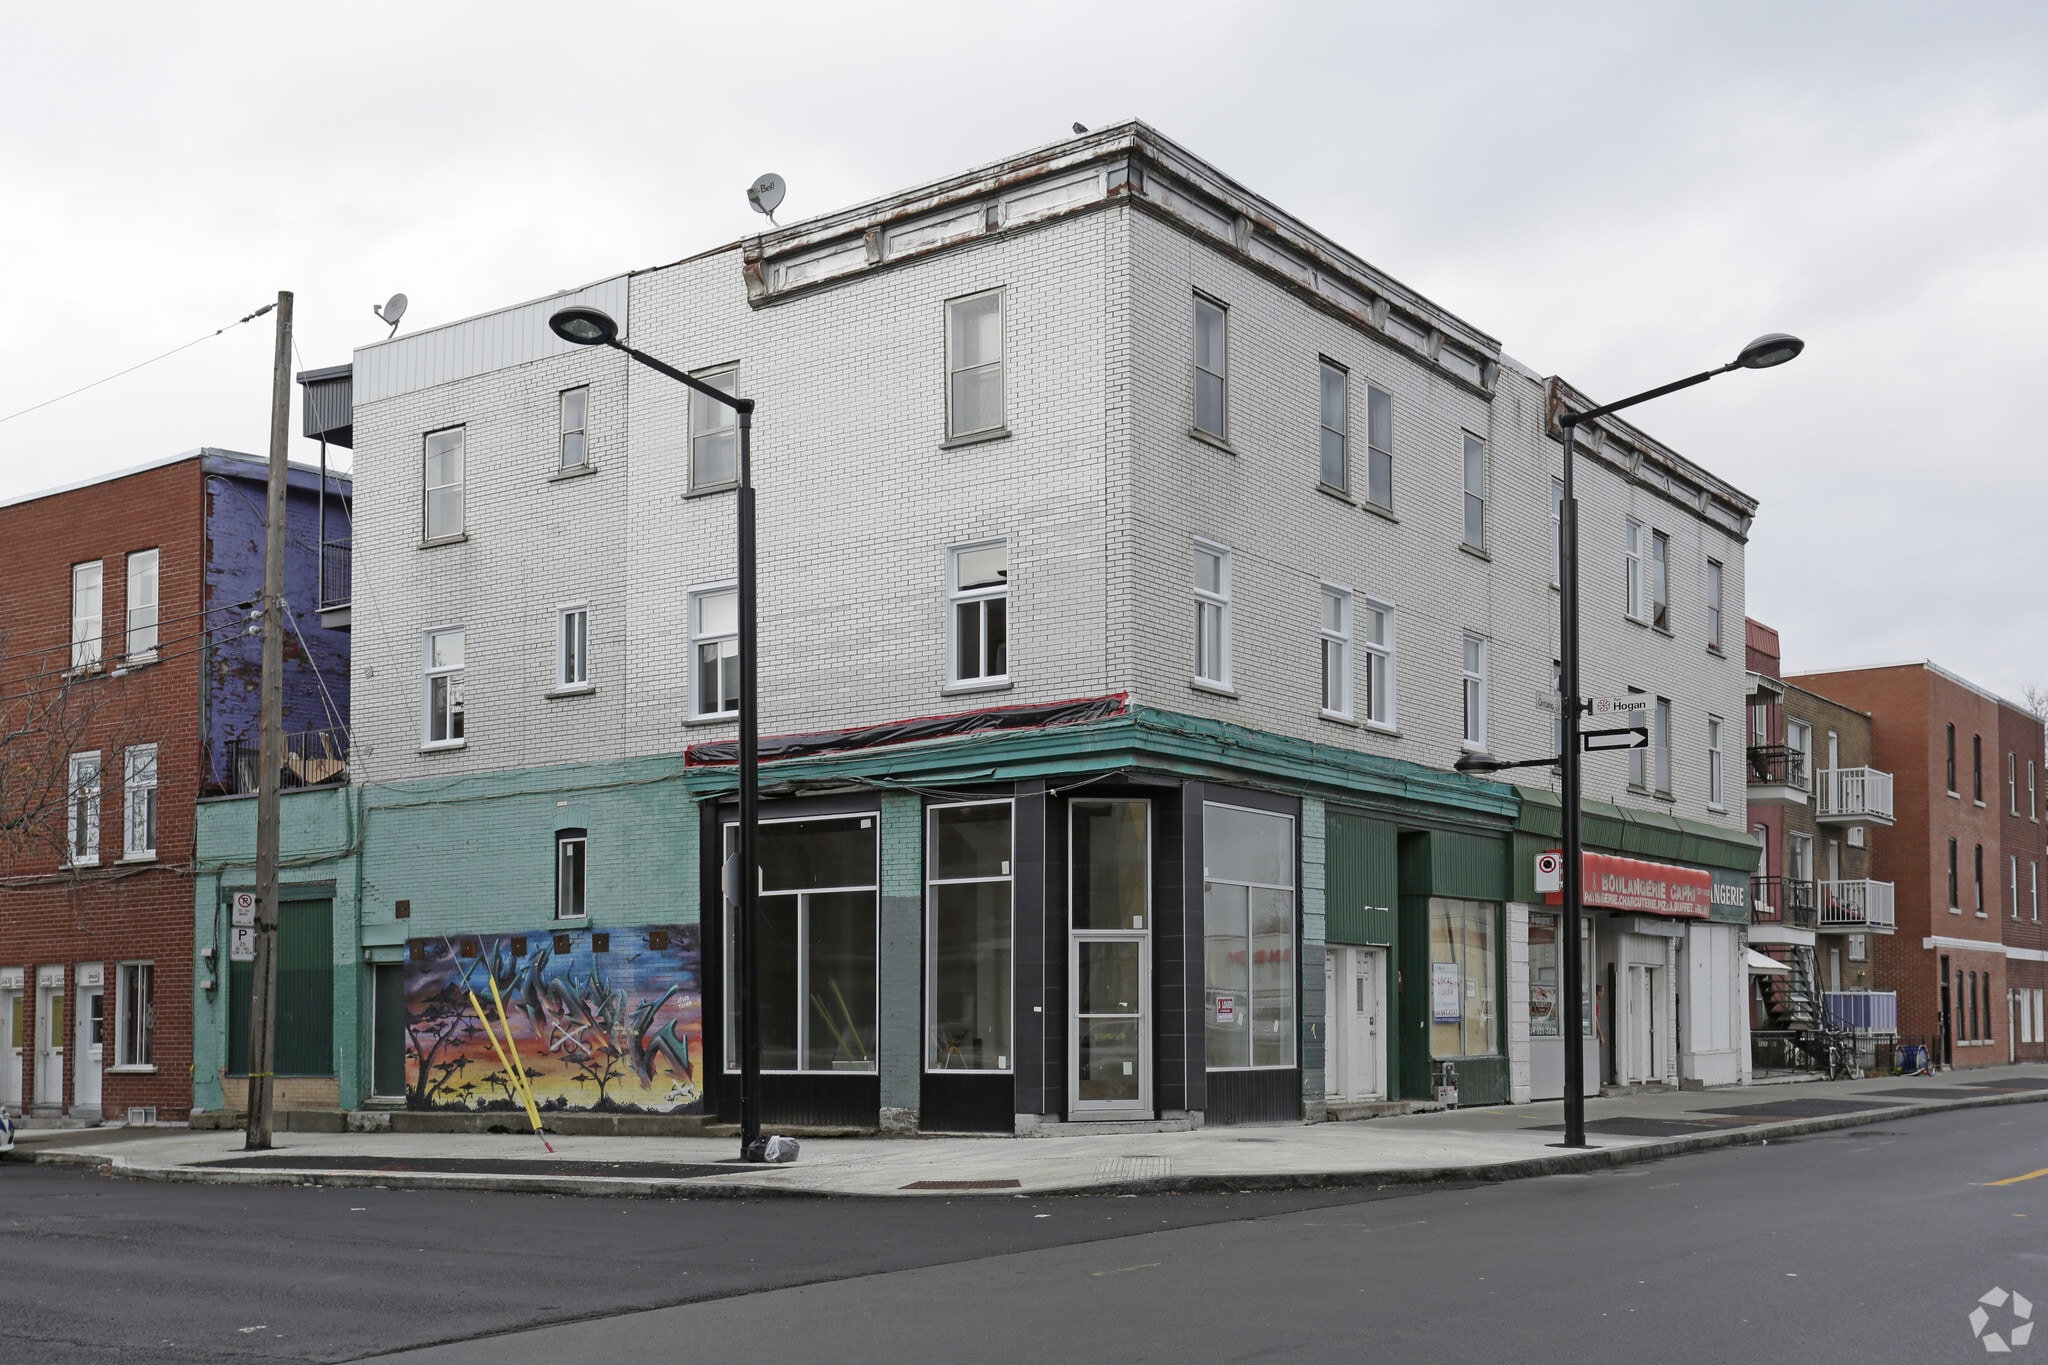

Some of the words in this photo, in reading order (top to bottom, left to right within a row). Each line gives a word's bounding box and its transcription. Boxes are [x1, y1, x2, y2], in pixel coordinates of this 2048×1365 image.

[760, 181, 775, 193] Bell
[1613, 701, 1646, 711] Hogan
[1601, 874, 1666, 899] BOULANGERIE
[1670, 883, 1696, 902] CAPRI
[238, 929, 247, 941] P
